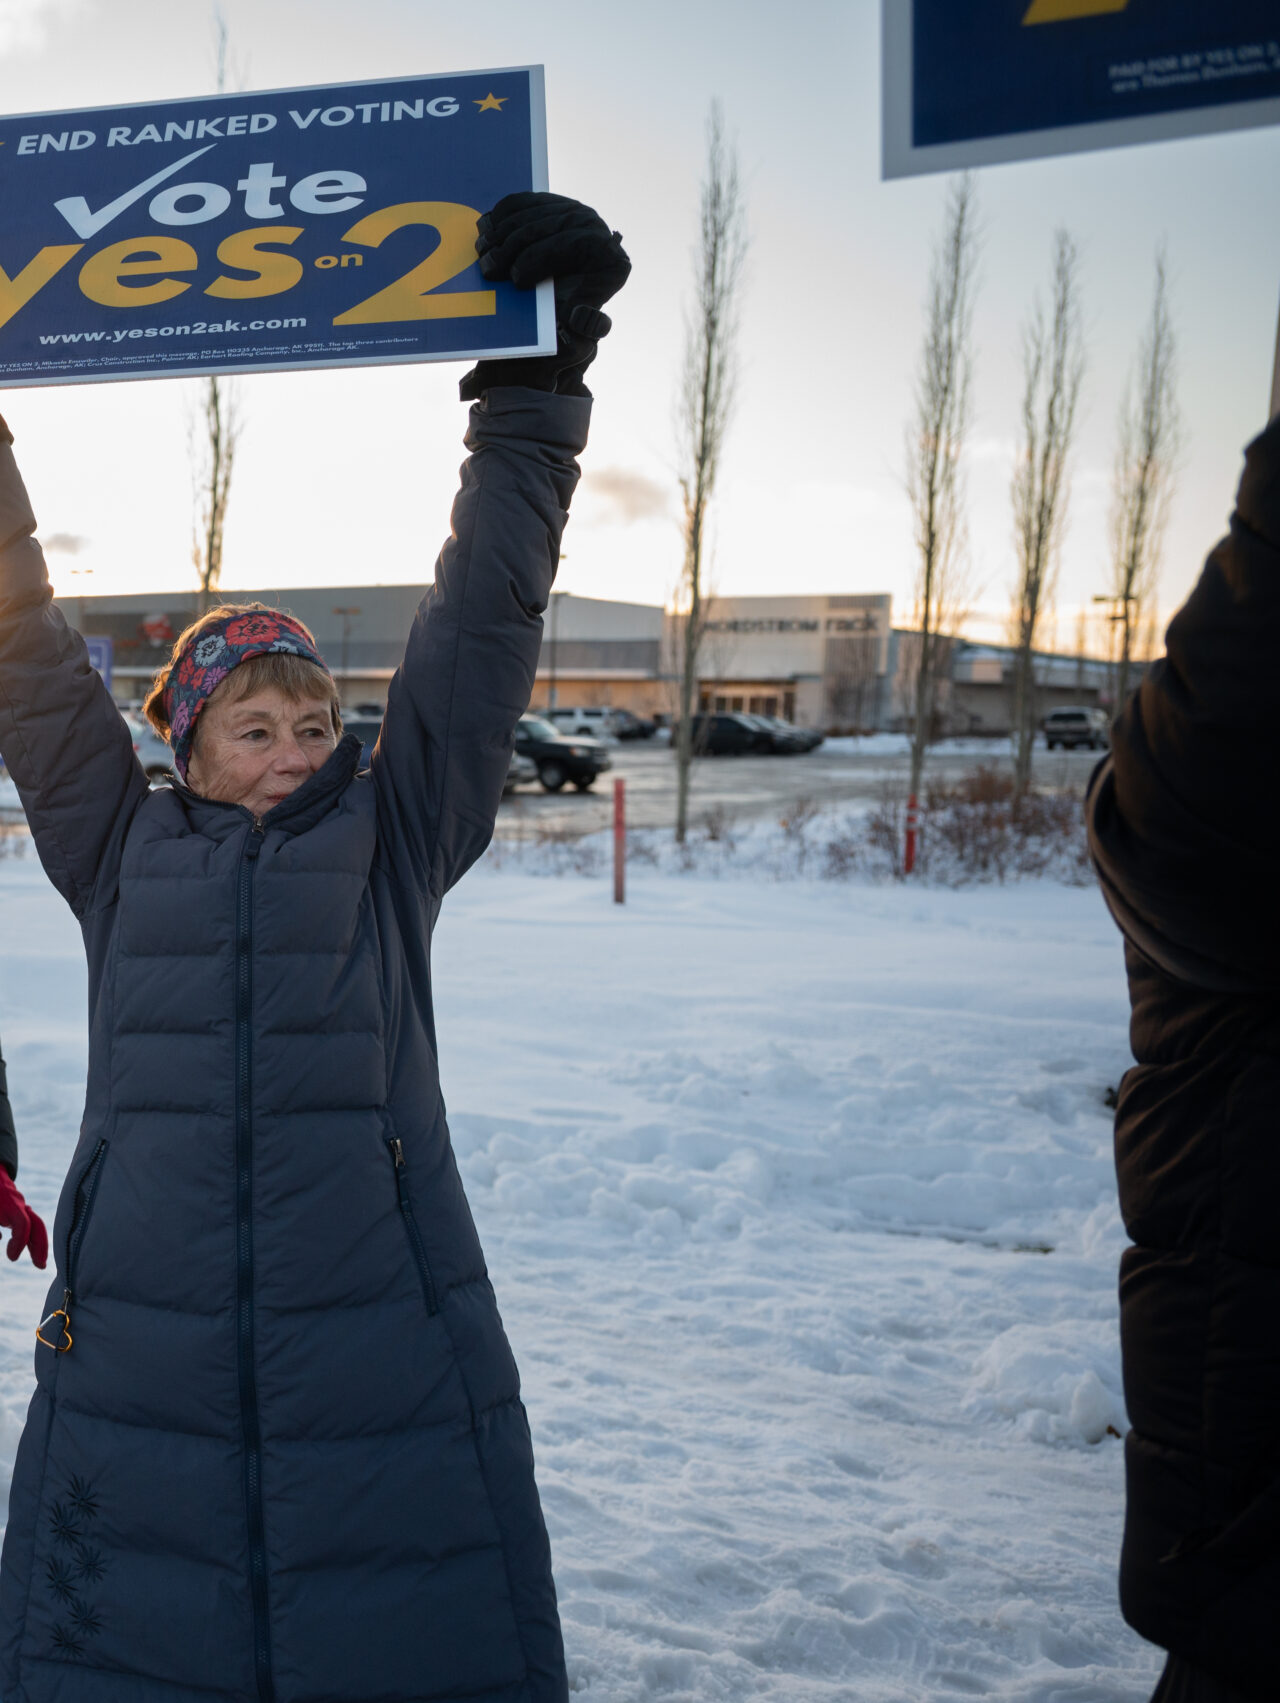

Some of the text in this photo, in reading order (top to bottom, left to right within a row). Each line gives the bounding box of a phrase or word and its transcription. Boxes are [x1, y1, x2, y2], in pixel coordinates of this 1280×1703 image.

[17, 96, 460, 155] END RANKED VOTING
[314, 253, 363, 269] on
[333, 201, 496, 326] 2
[39, 317, 307, 344] www.yeson2ak.com
